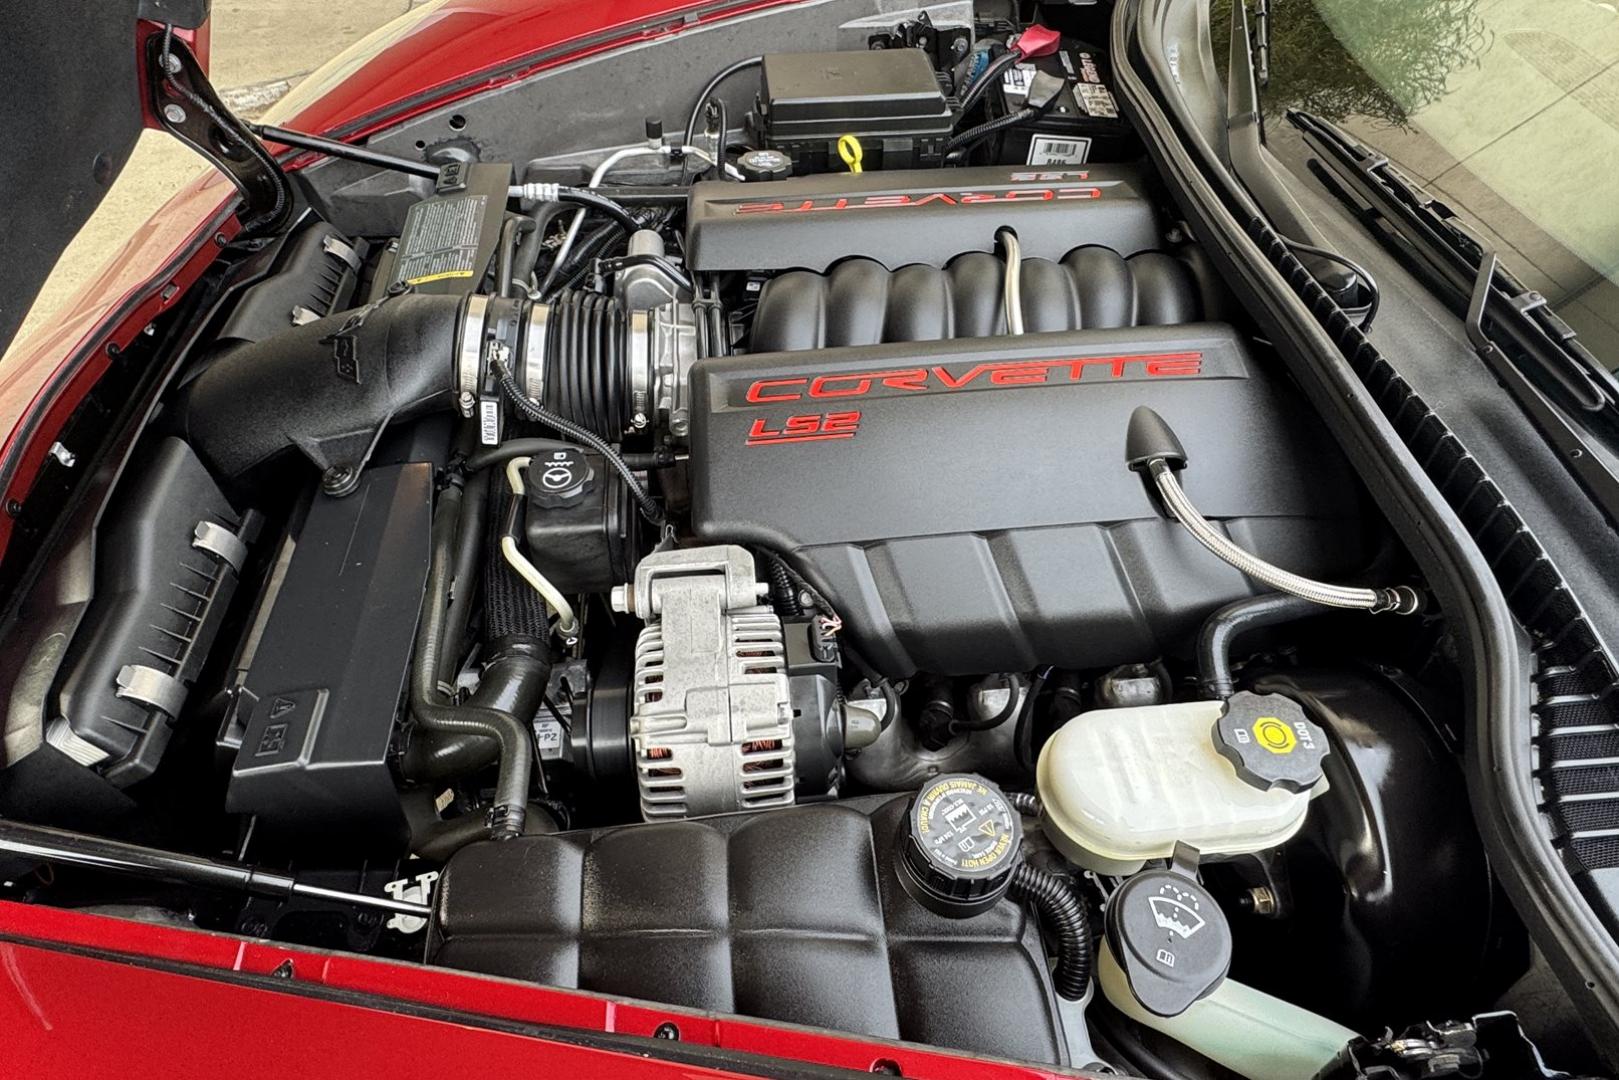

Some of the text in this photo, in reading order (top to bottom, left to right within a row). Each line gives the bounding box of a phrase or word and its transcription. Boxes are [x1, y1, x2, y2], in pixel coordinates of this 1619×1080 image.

[734, 187, 1101, 216] CORVETTE
[745, 352, 1203, 404] CORVETTE
[747, 410, 862, 438] LS2
[1294, 721, 1315, 749] DOT 3
[994, 833, 1009, 855] NEVER
